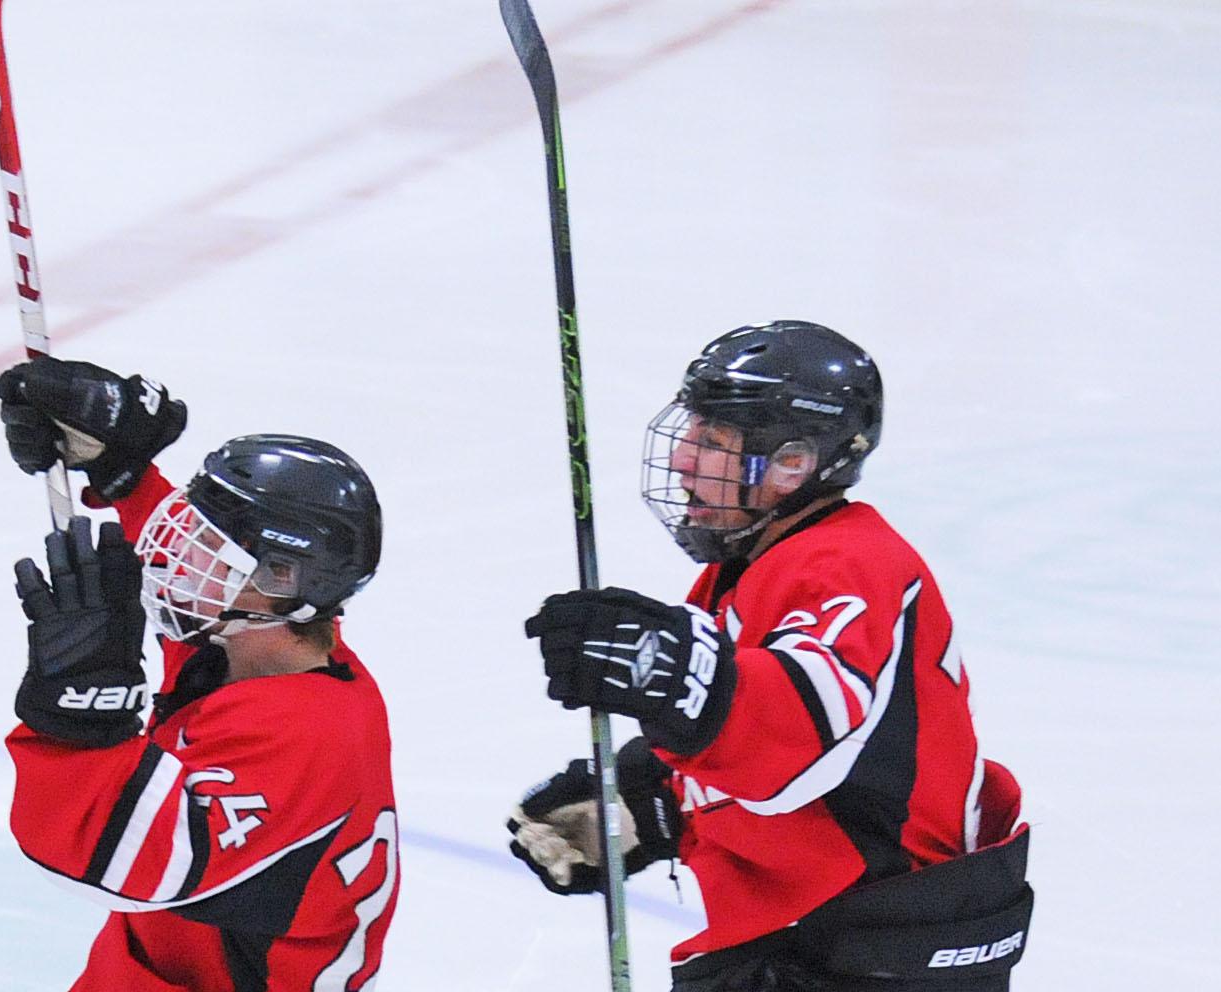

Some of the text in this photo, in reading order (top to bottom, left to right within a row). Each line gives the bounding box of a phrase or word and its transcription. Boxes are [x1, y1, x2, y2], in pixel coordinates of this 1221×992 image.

[261, 528, 311, 548] CCM
[57, 682, 148, 710] UER
[928, 931, 1025, 968] BAUER
